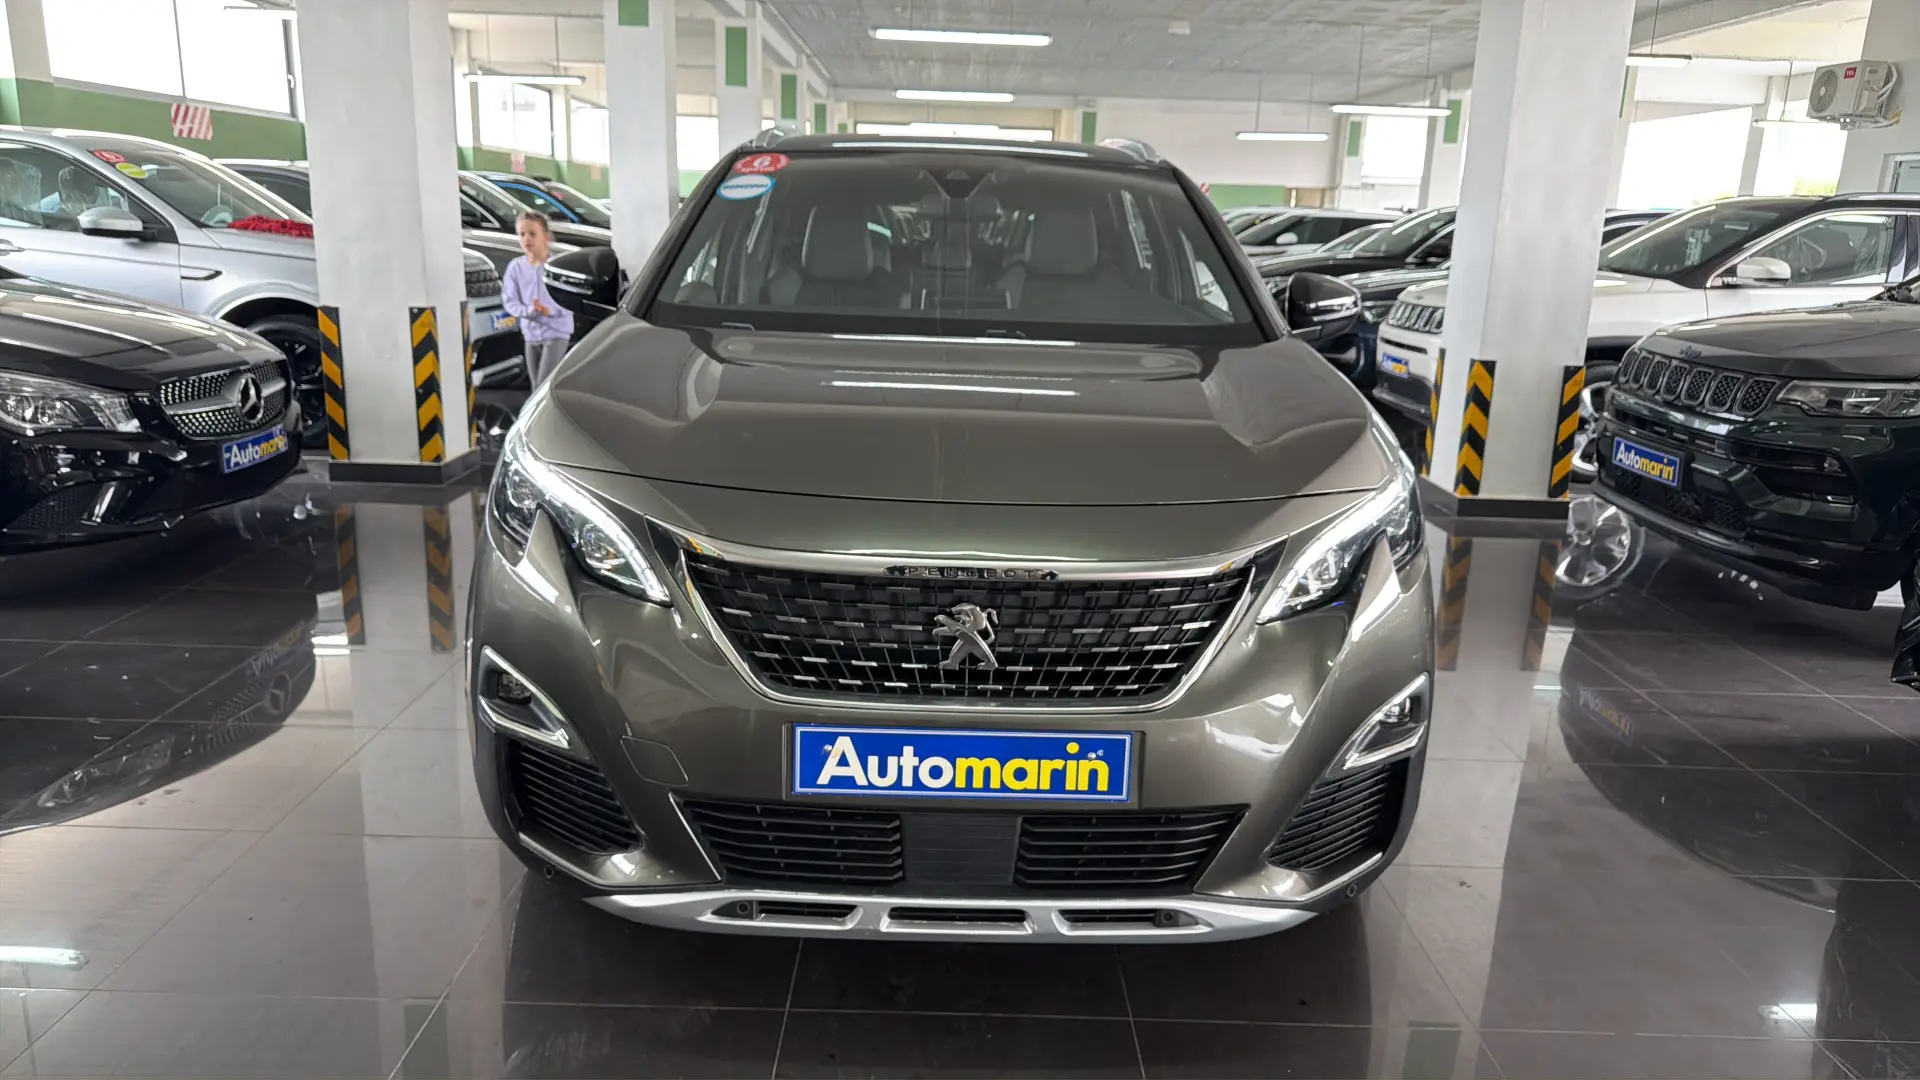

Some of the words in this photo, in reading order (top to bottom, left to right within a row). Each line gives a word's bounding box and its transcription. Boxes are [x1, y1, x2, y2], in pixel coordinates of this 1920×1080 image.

[1615, 442, 1674, 481] Automarin
[904, 566, 1035, 579] PEUGEOT
[816, 736, 1109, 792] Automarin
